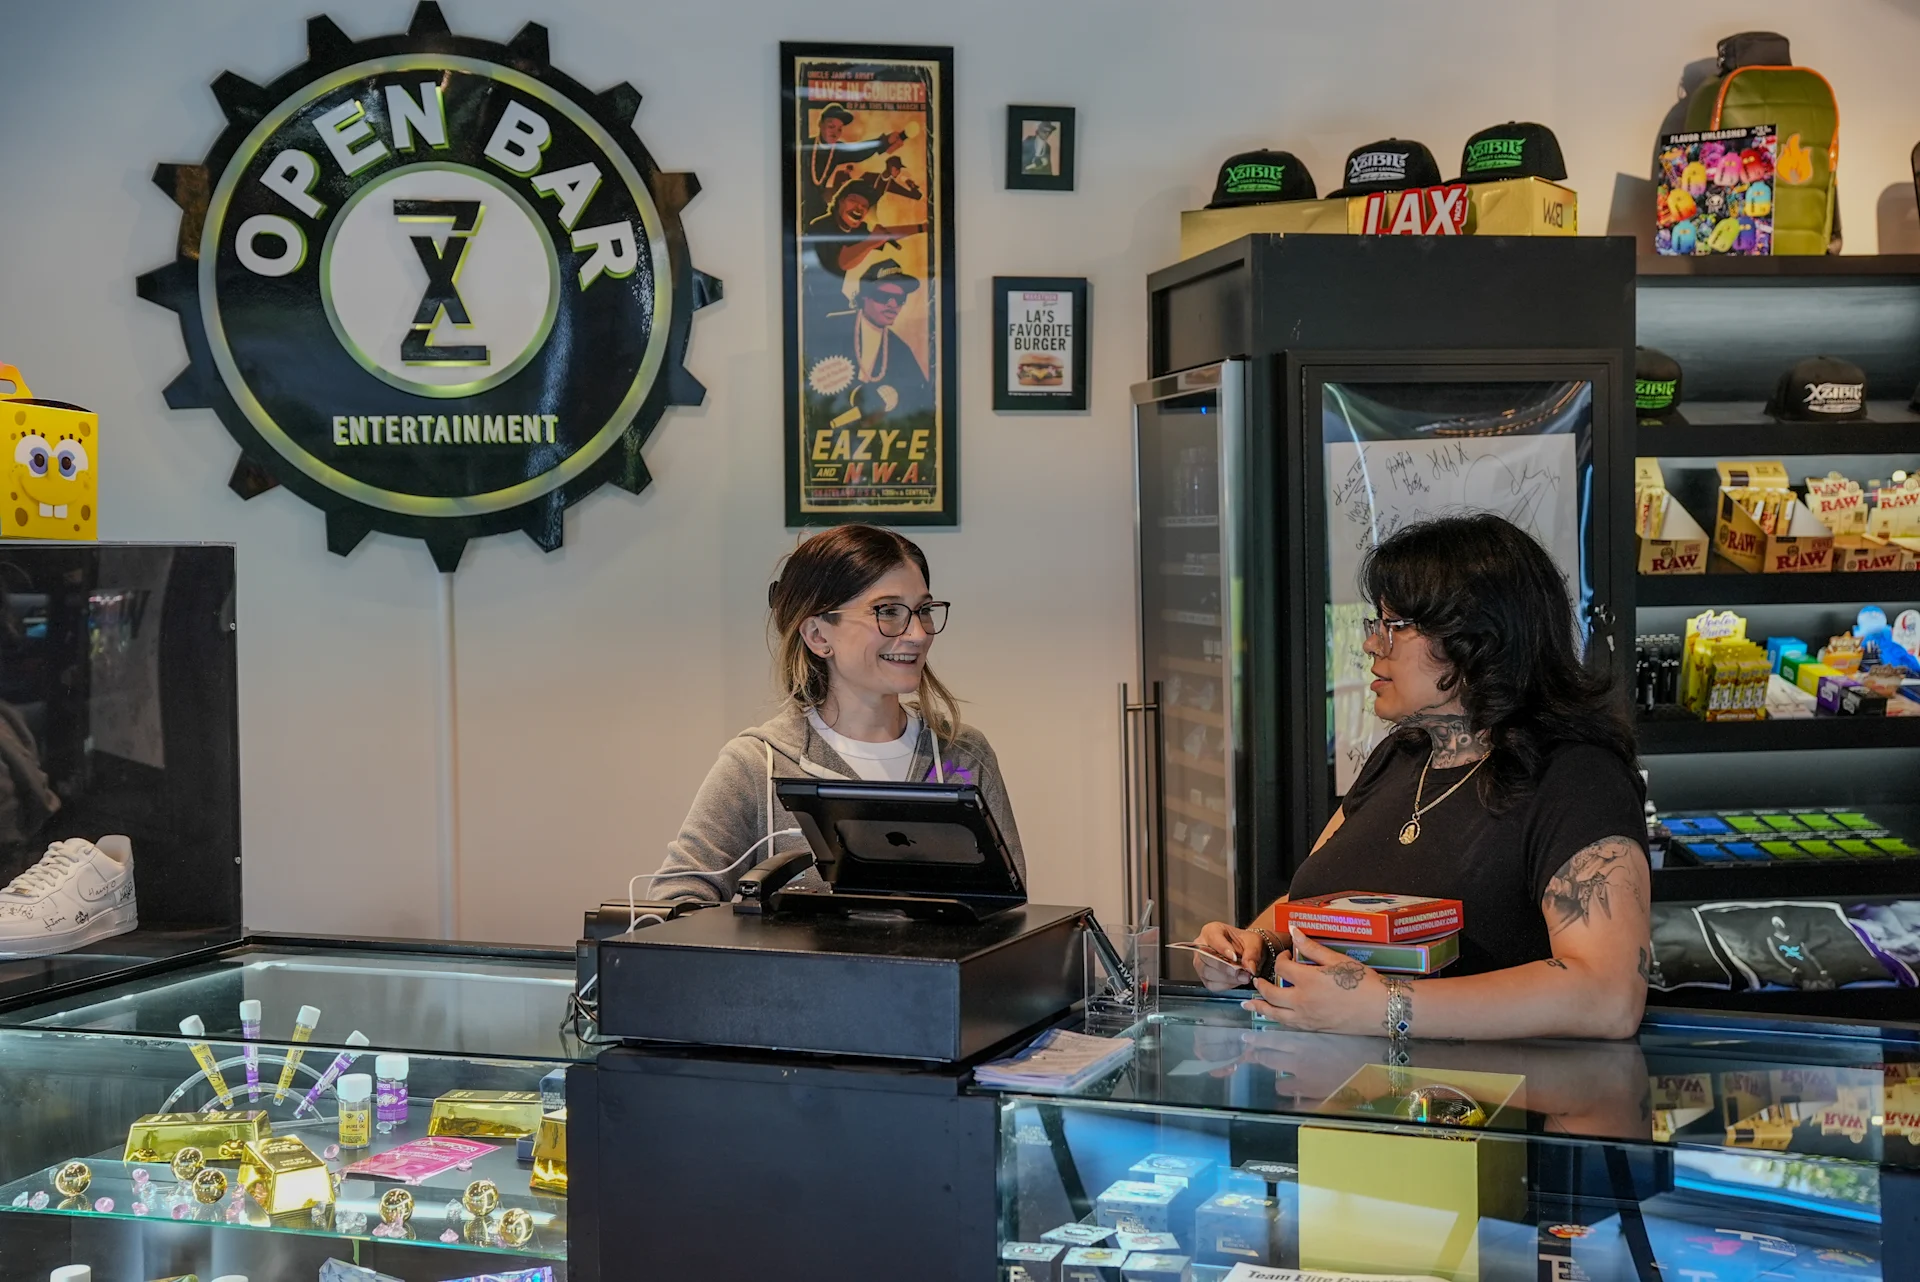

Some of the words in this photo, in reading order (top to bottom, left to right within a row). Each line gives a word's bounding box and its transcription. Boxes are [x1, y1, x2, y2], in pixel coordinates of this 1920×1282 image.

[814, 81, 843, 101] LIVE
[846, 82, 860, 101] IN
[864, 81, 920, 101] CONCERT
[1670, 133, 1700, 144] FLAVOR
[1701, 129, 1747, 141] UNLEASHED
[235, 81, 449, 278] OPEN
[483, 100, 638, 291] BAR
[1026, 310, 1054, 323] LA'S
[1009, 324, 1072, 337] FAVORITE
[1014, 337, 1066, 350] BURGER
[333, 414, 558, 446] ENTERTAINMENT
[812, 429, 929, 460] EAZY-E
[817, 468, 836, 477] AND
[843, 462, 926, 484] N.W.A.
[1812, 482, 1846, 495] RAW
[1821, 495, 1859, 512] RAW
[1881, 493, 1920, 509] RAW
[1728, 531, 1756, 553] RAW
[1652, 554, 1699, 571] RAW
[1776, 550, 1827, 570] RAW
[1858, 554, 1896, 571] RAW
[1289, 911, 1371, 926] @PERMANENTHOLIDAYCA
[1394, 908, 1457, 926] @PERMANENTHOLIDAYCA
[1288, 920, 1373, 935] PERMANENTHOLIDAY.COM
[1393, 916, 1458, 936] PERMANENTHOLIDAY.COM
[1248, 1270, 1291, 1282] Team
